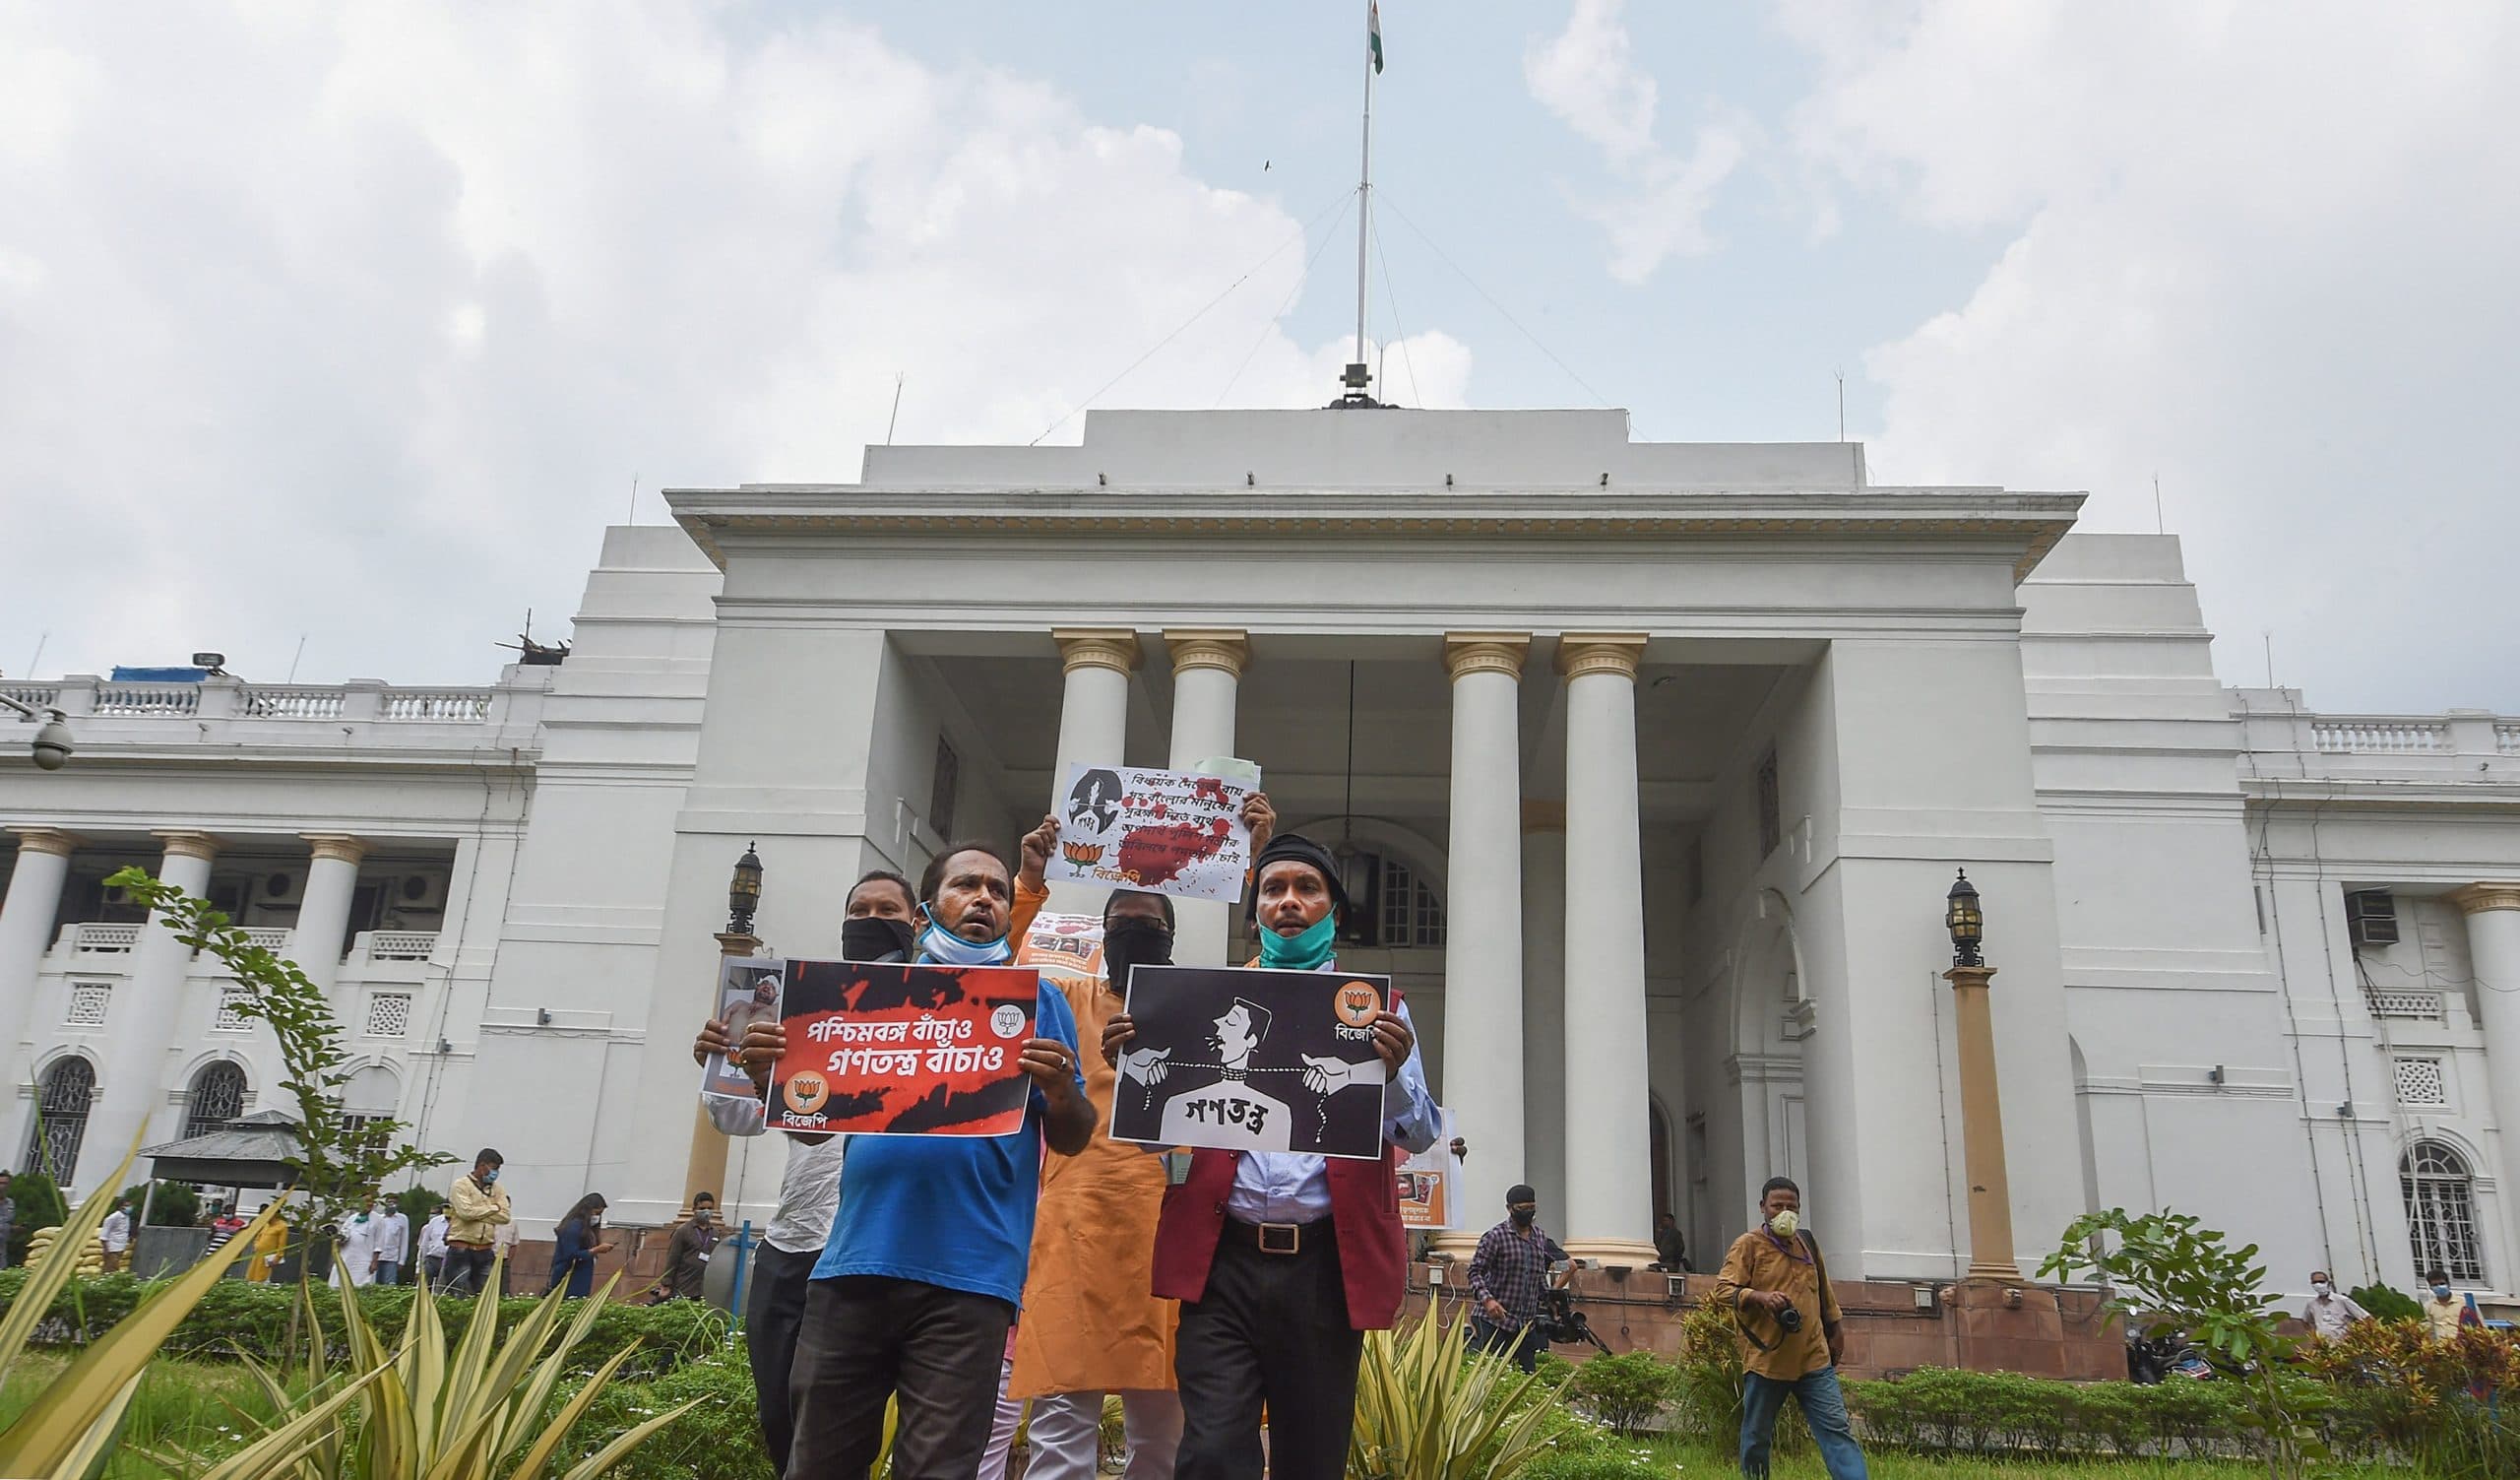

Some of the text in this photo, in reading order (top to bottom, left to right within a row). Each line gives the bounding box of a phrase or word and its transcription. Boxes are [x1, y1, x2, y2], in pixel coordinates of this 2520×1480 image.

[1190, 798, 1236, 813] মানুষের
[1219, 852, 1241, 865] চাই
[1092, 866, 1141, 884] বিজেপি
[807, 1013, 973, 1042] পশ্চিমবঙ্গ বাঁচাও
[827, 1037, 1004, 1076] গণতন্ত্র বাঁচাও
[782, 1110, 829, 1129] বিজেপি
[1185, 1098, 1269, 1135] গণতন্ত্র
